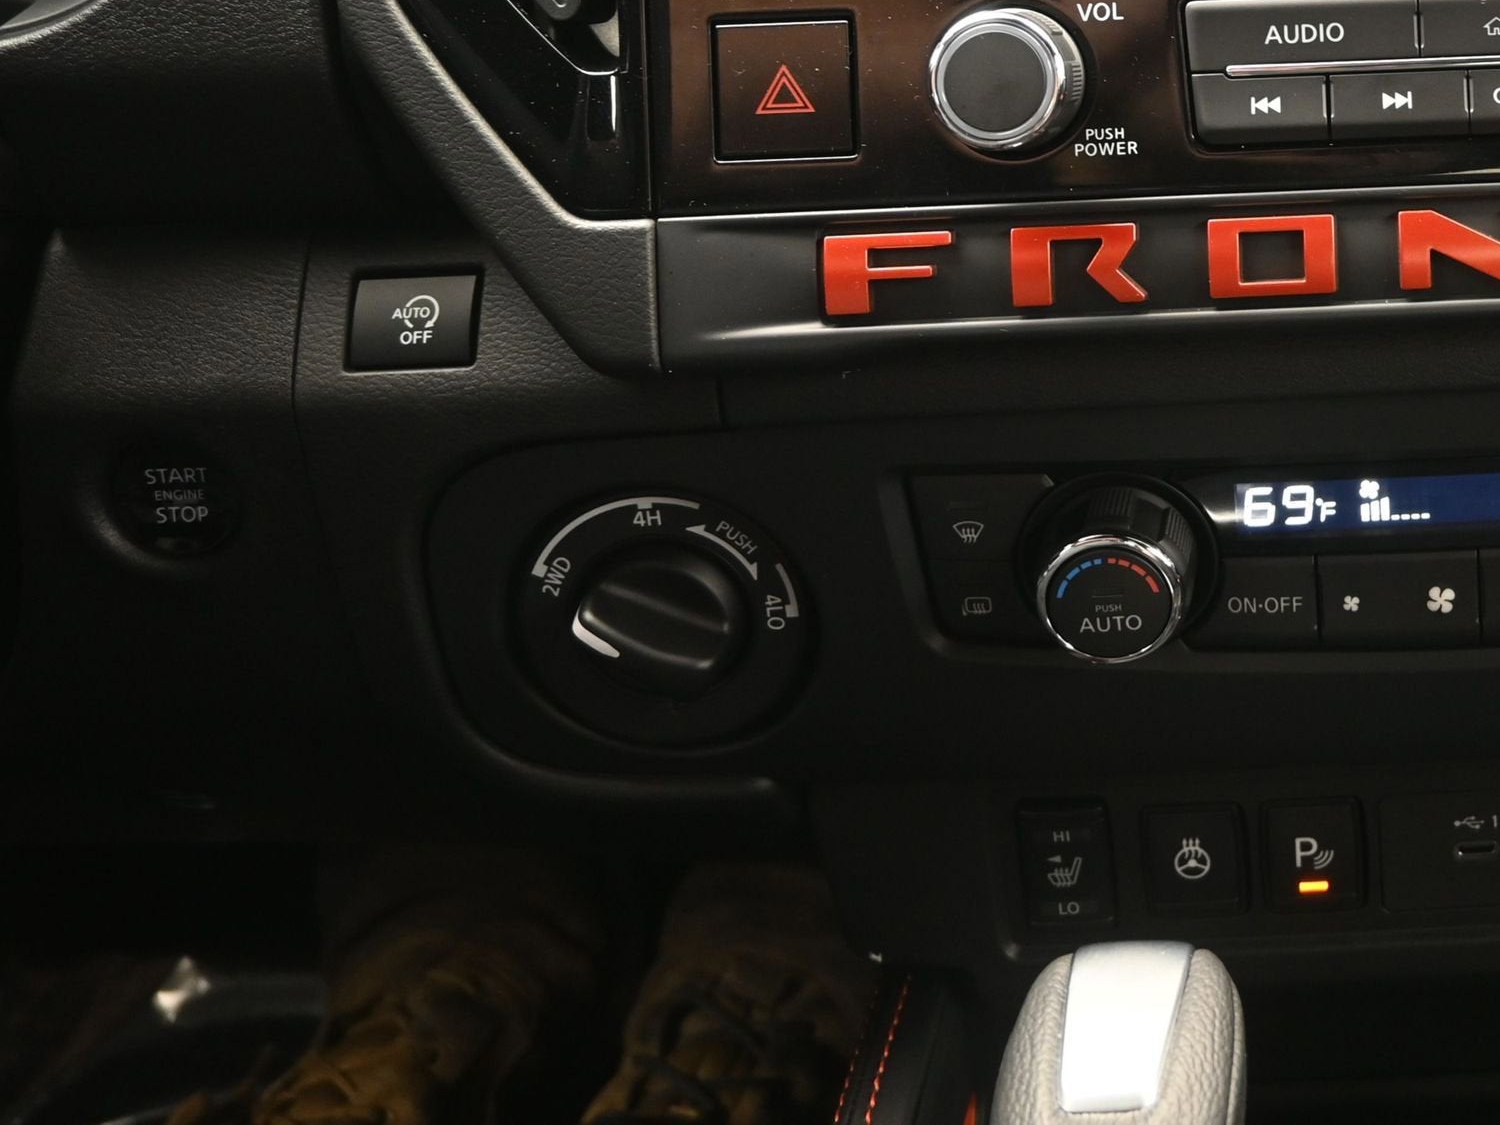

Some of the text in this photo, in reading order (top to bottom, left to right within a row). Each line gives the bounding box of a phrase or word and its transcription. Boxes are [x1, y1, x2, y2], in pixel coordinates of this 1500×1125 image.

[1076, 3, 1124, 22] VOL
[1265, 23, 1345, 45] AUDIO
[1085, 128, 1126, 142] PUSH
[1074, 141, 1139, 157] POWER
[391, 307, 431, 320] AUTO
[400, 330, 433, 345] OFF
[144, 467, 207, 485] START
[154, 489, 205, 501] ENGINE
[155, 506, 209, 524] STOP
[632, 510, 662, 528] 4H
[715, 520, 758, 556] PUSH
[541, 556, 572, 597] 2WD
[765, 594, 786, 631] 4LO
[1095, 602, 1123, 613] PUSH
[1079, 614, 1143, 634] AUTO
[1491, 814, 1499, 829] 1
[1052, 829, 1071, 844] HI
[1057, 902, 1080, 916] LO
